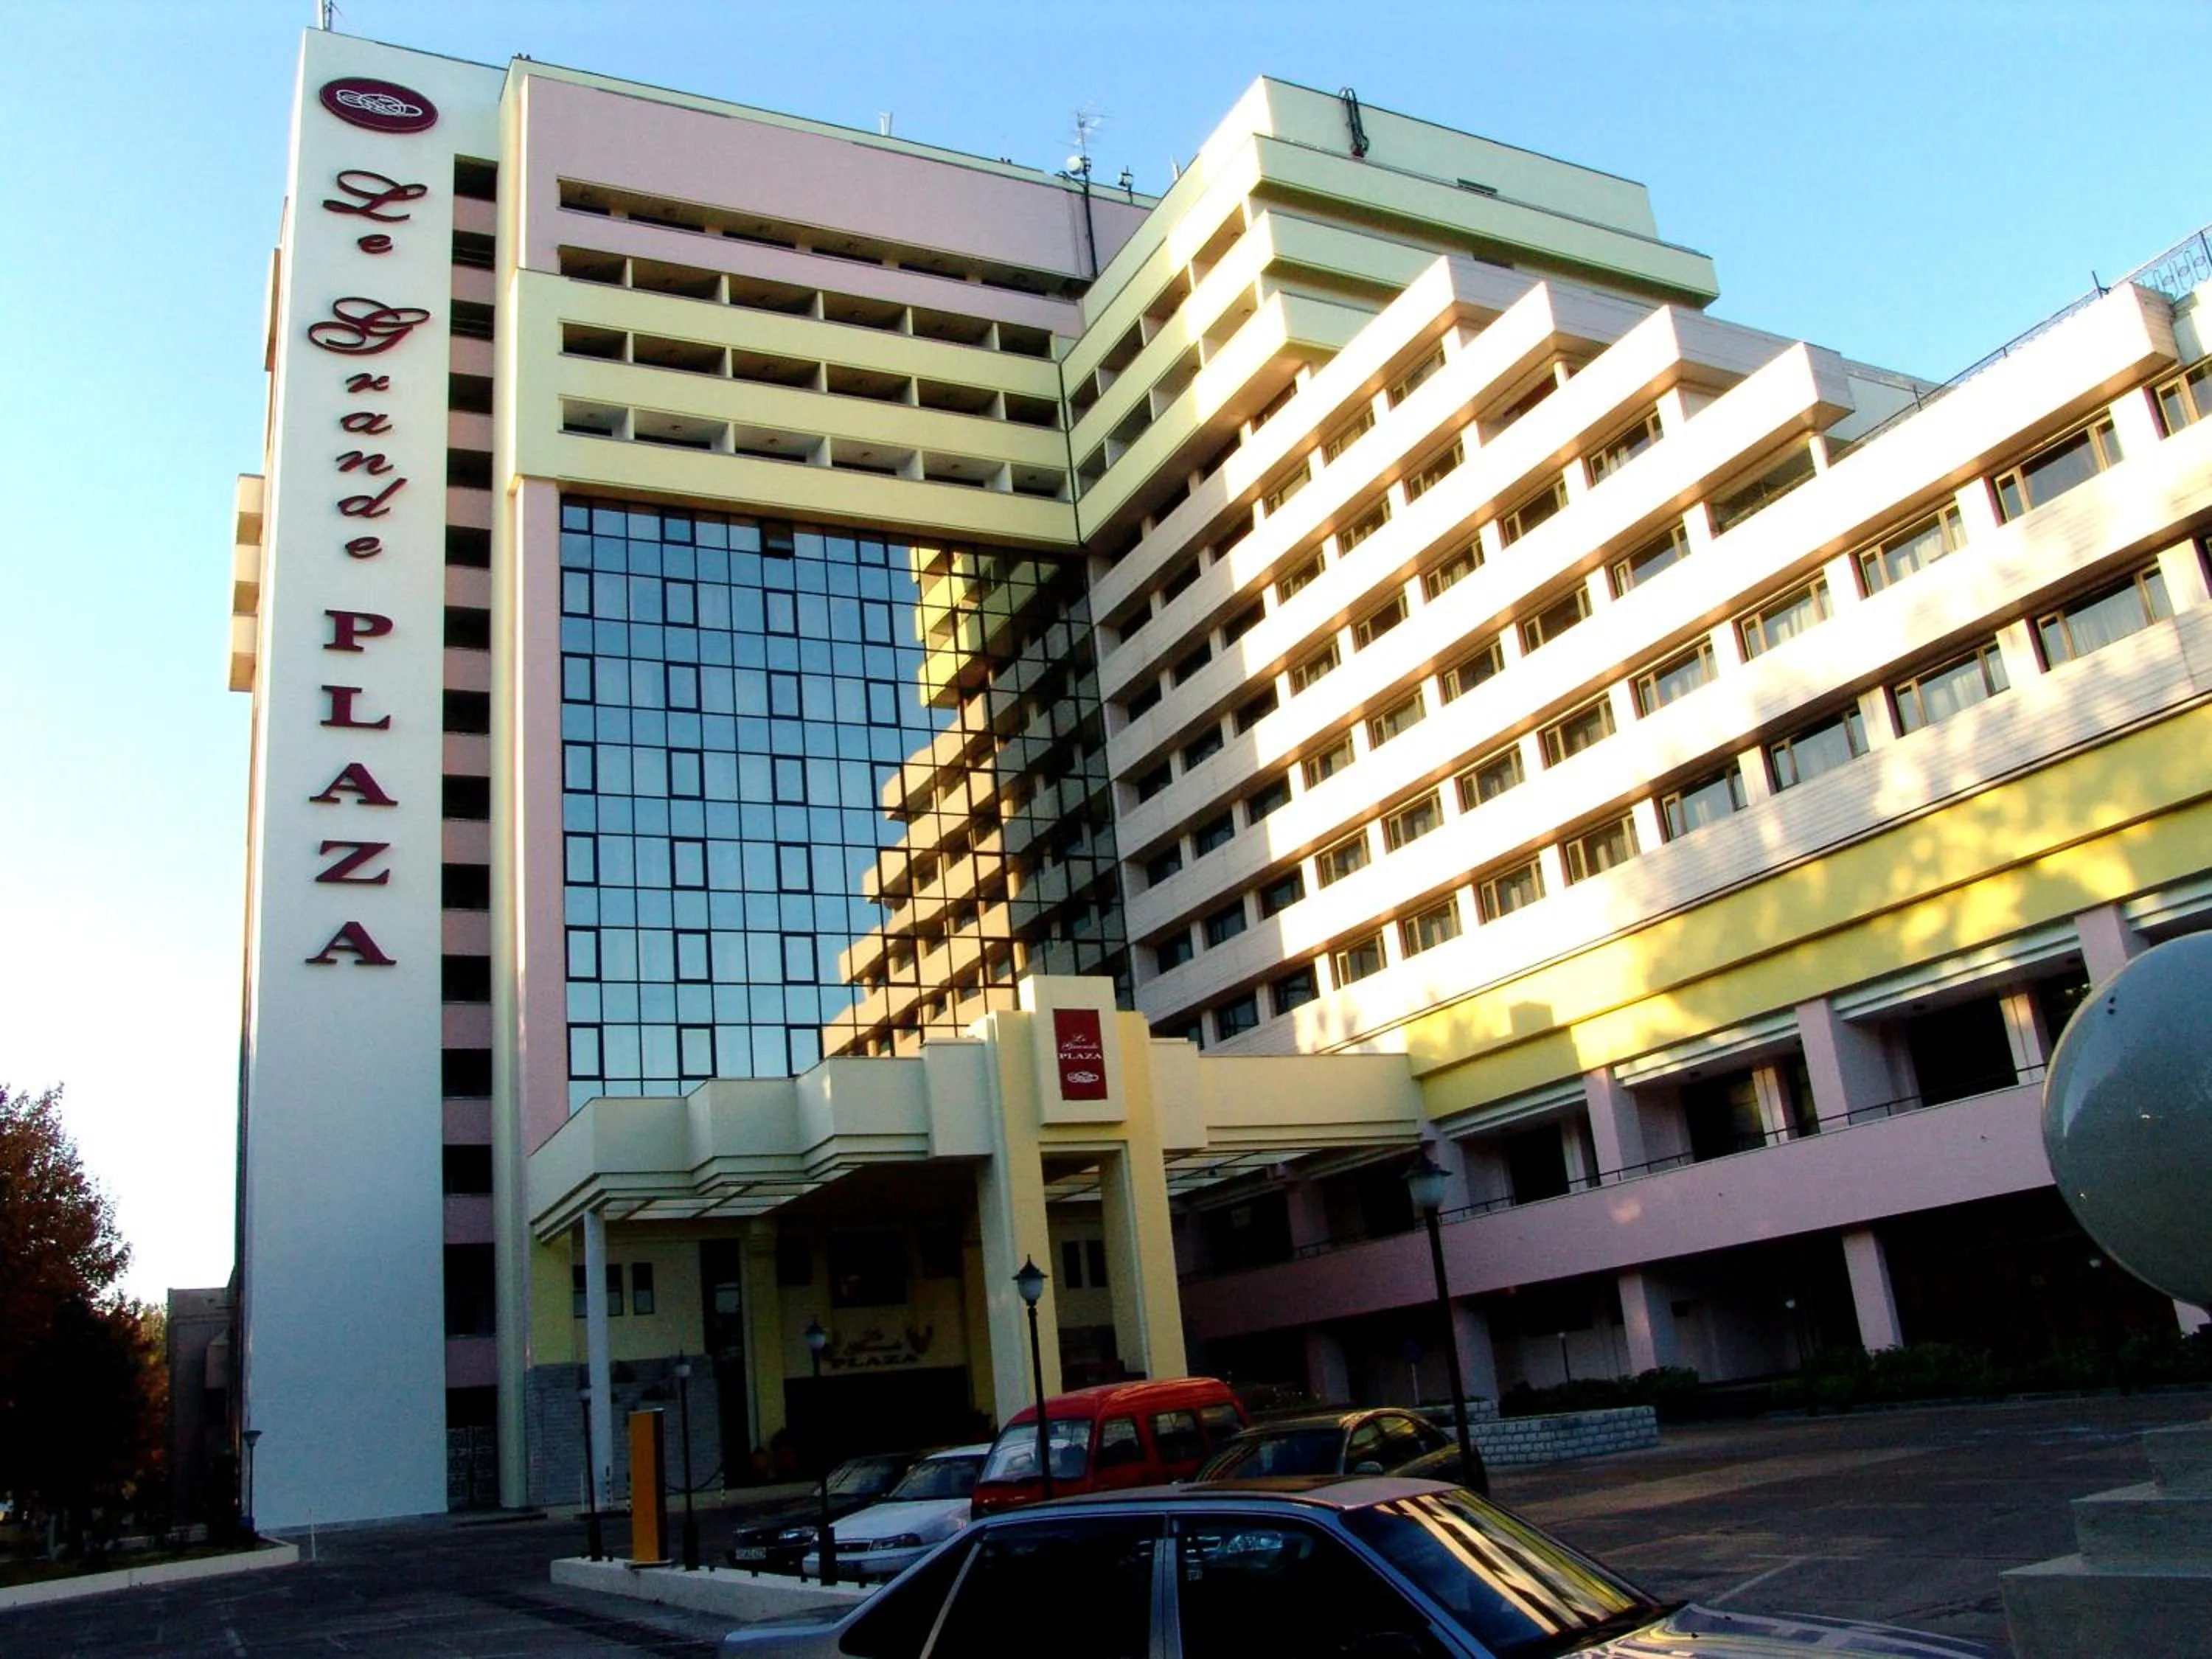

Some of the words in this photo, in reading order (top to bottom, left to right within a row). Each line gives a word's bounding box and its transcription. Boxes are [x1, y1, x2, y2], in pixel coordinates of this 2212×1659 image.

[322, 170, 428, 254] Le
[307, 296, 431, 559] Grande
[305, 609, 399, 967] PLAZA
[1059, 1052, 1102, 1060] PLAZA
